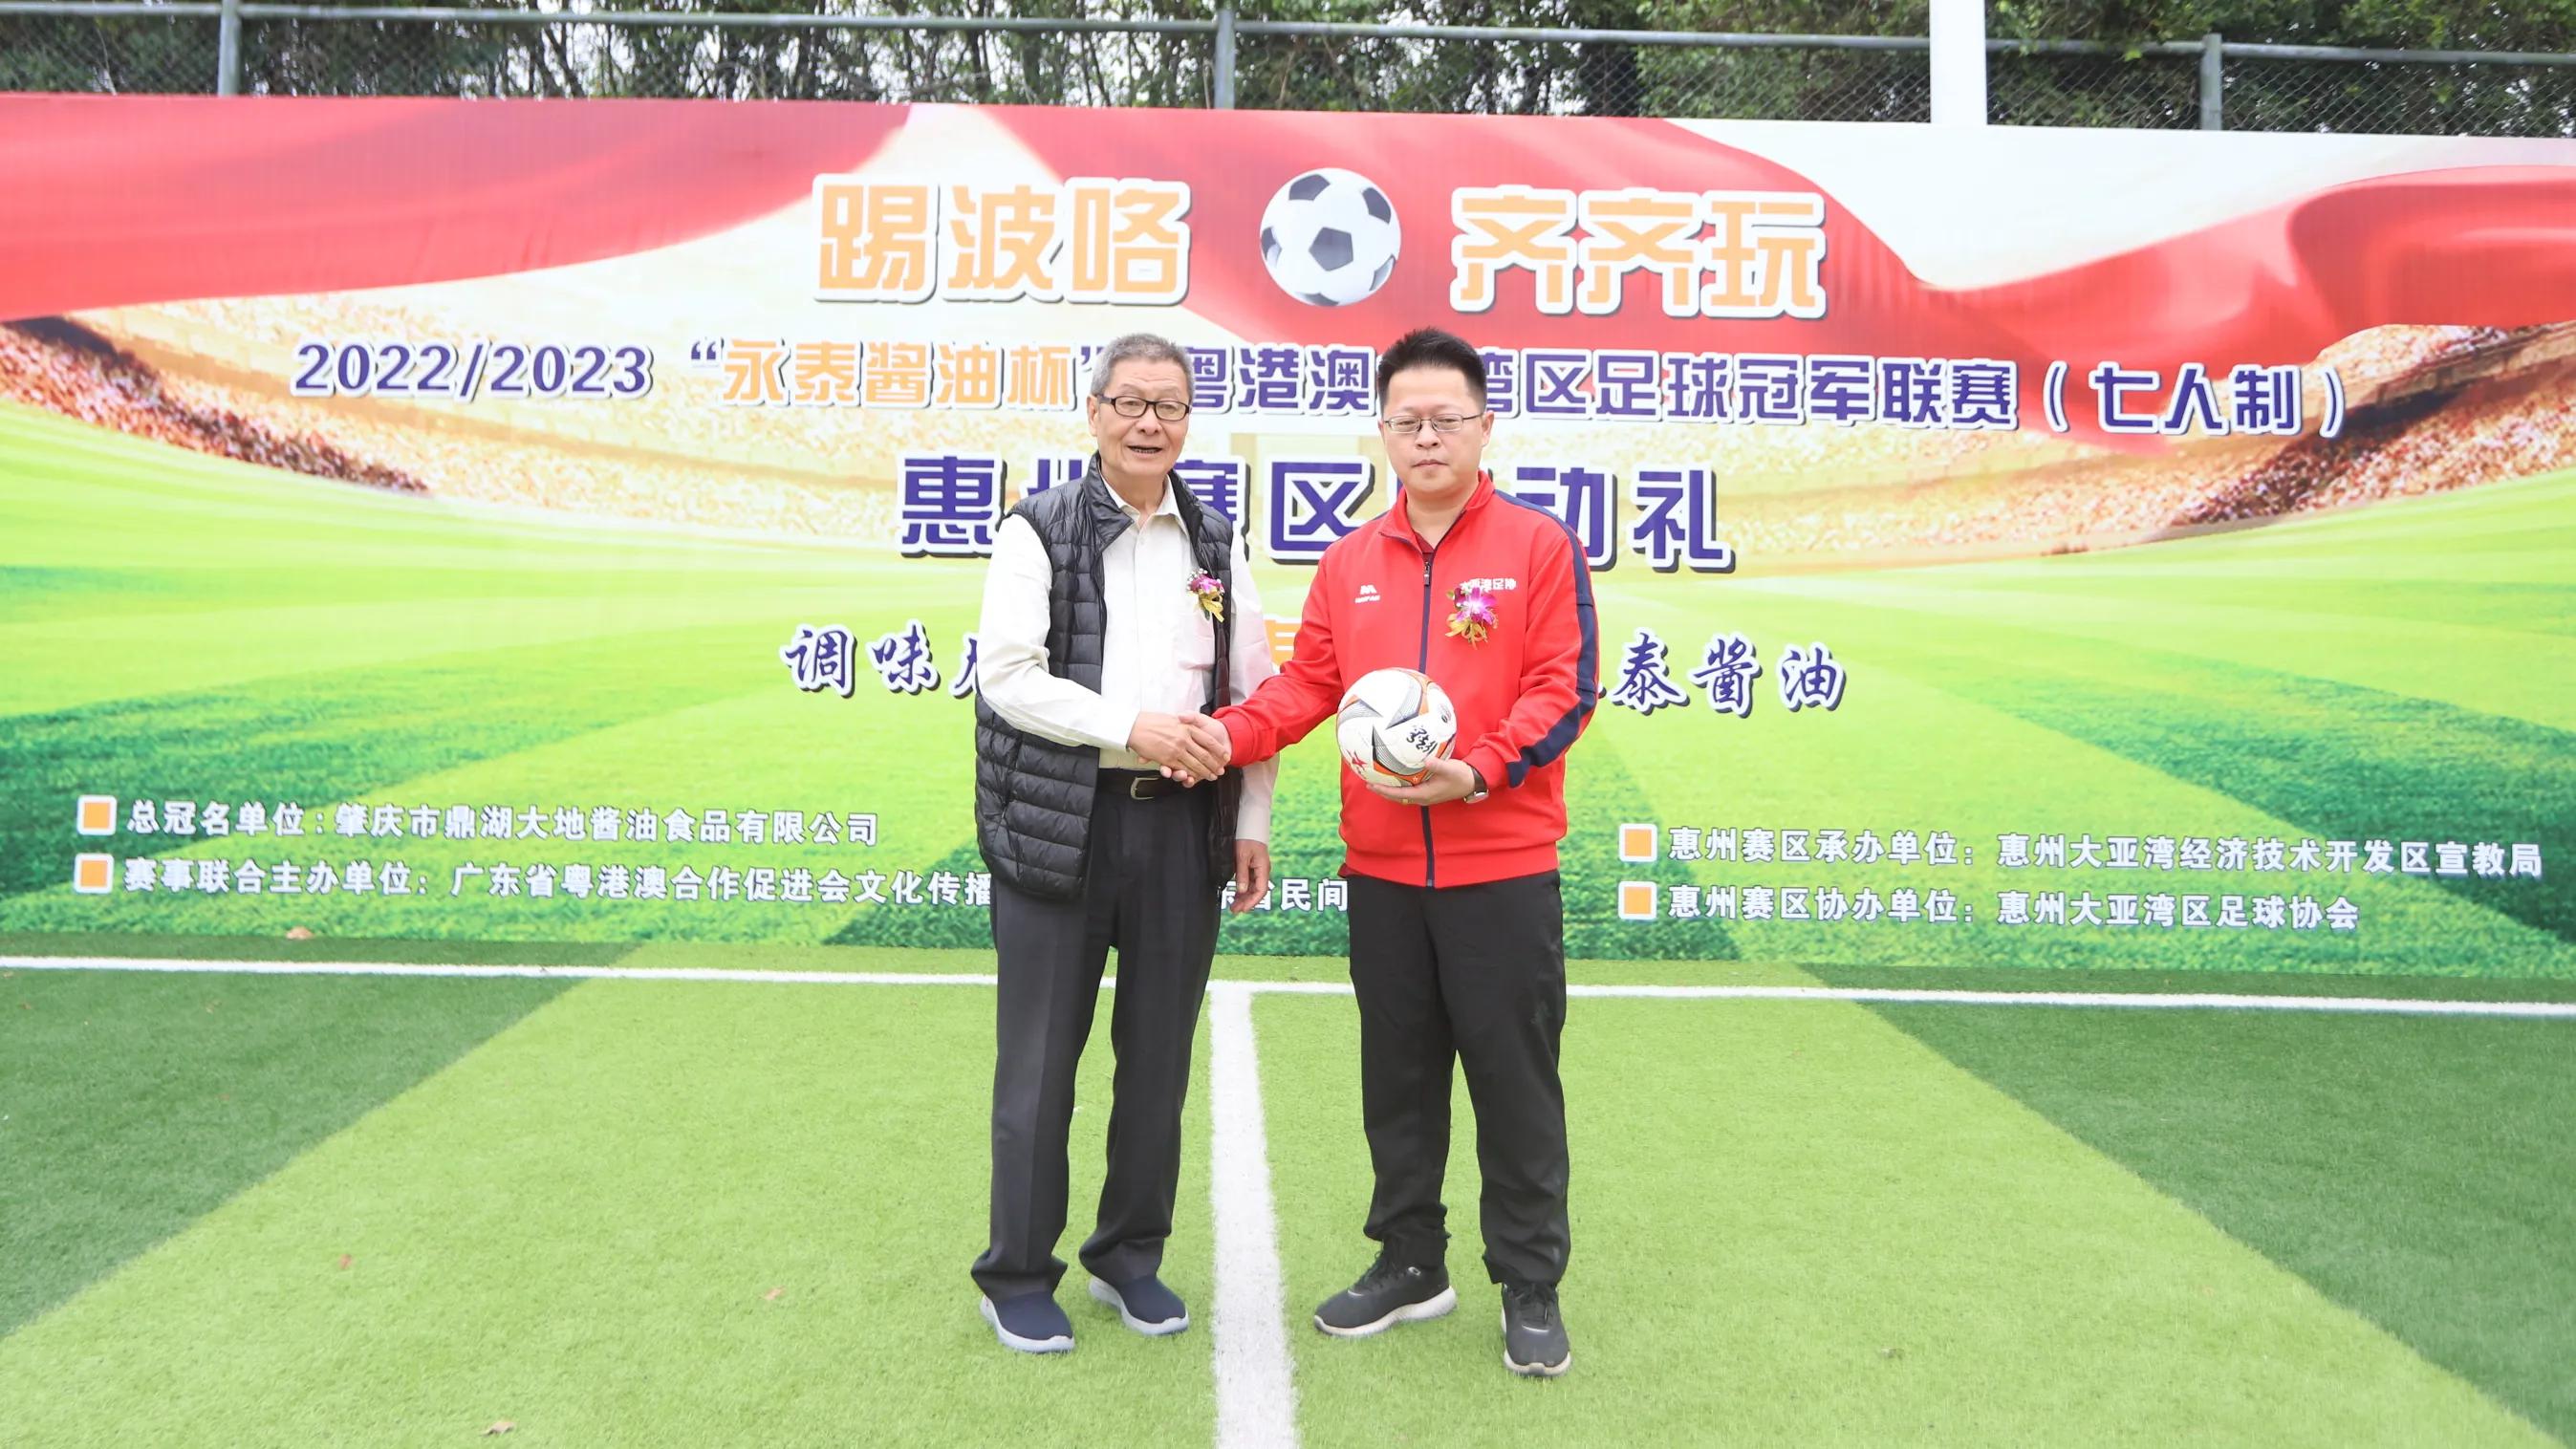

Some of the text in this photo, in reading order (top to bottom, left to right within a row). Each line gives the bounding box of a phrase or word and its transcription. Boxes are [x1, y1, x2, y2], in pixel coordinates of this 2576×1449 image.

[817, 180, 1824, 314] 踢波咯 齐齐玩
[294, 341, 652, 400] 2022/2023
[785, 624, 978, 690] 调味
